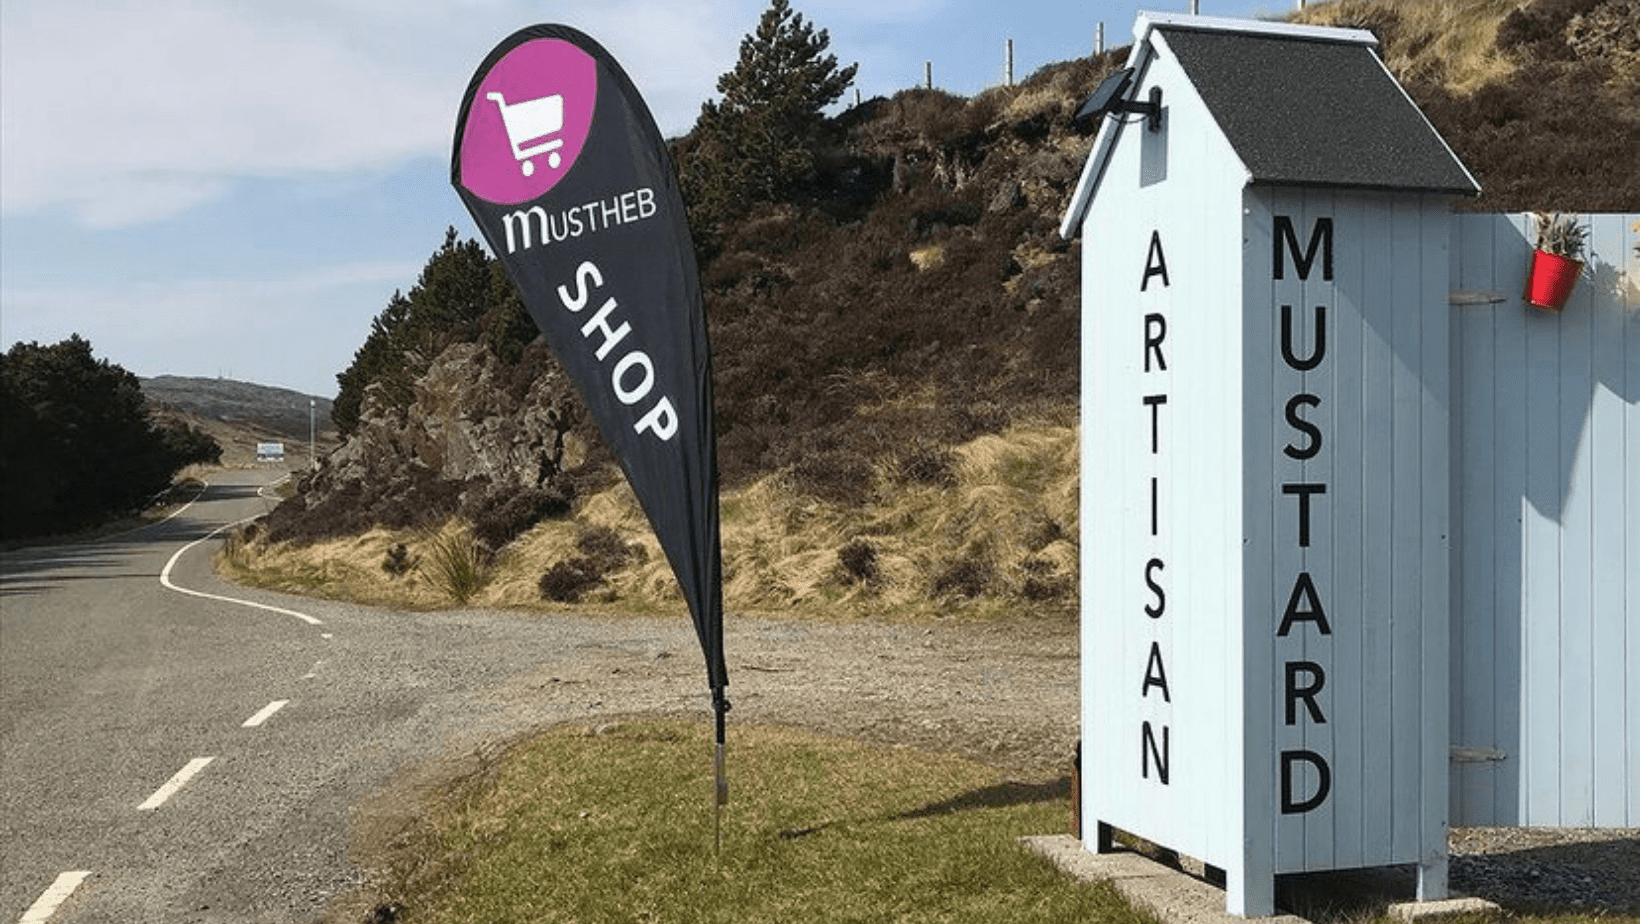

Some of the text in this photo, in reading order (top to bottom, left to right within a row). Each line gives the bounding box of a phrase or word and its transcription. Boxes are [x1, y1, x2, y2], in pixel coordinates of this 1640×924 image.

[557, 261, 679, 442] SHOP
[1140, 229, 1171, 786] ARTISAN
[1272, 215, 1335, 816] MUSTARD
